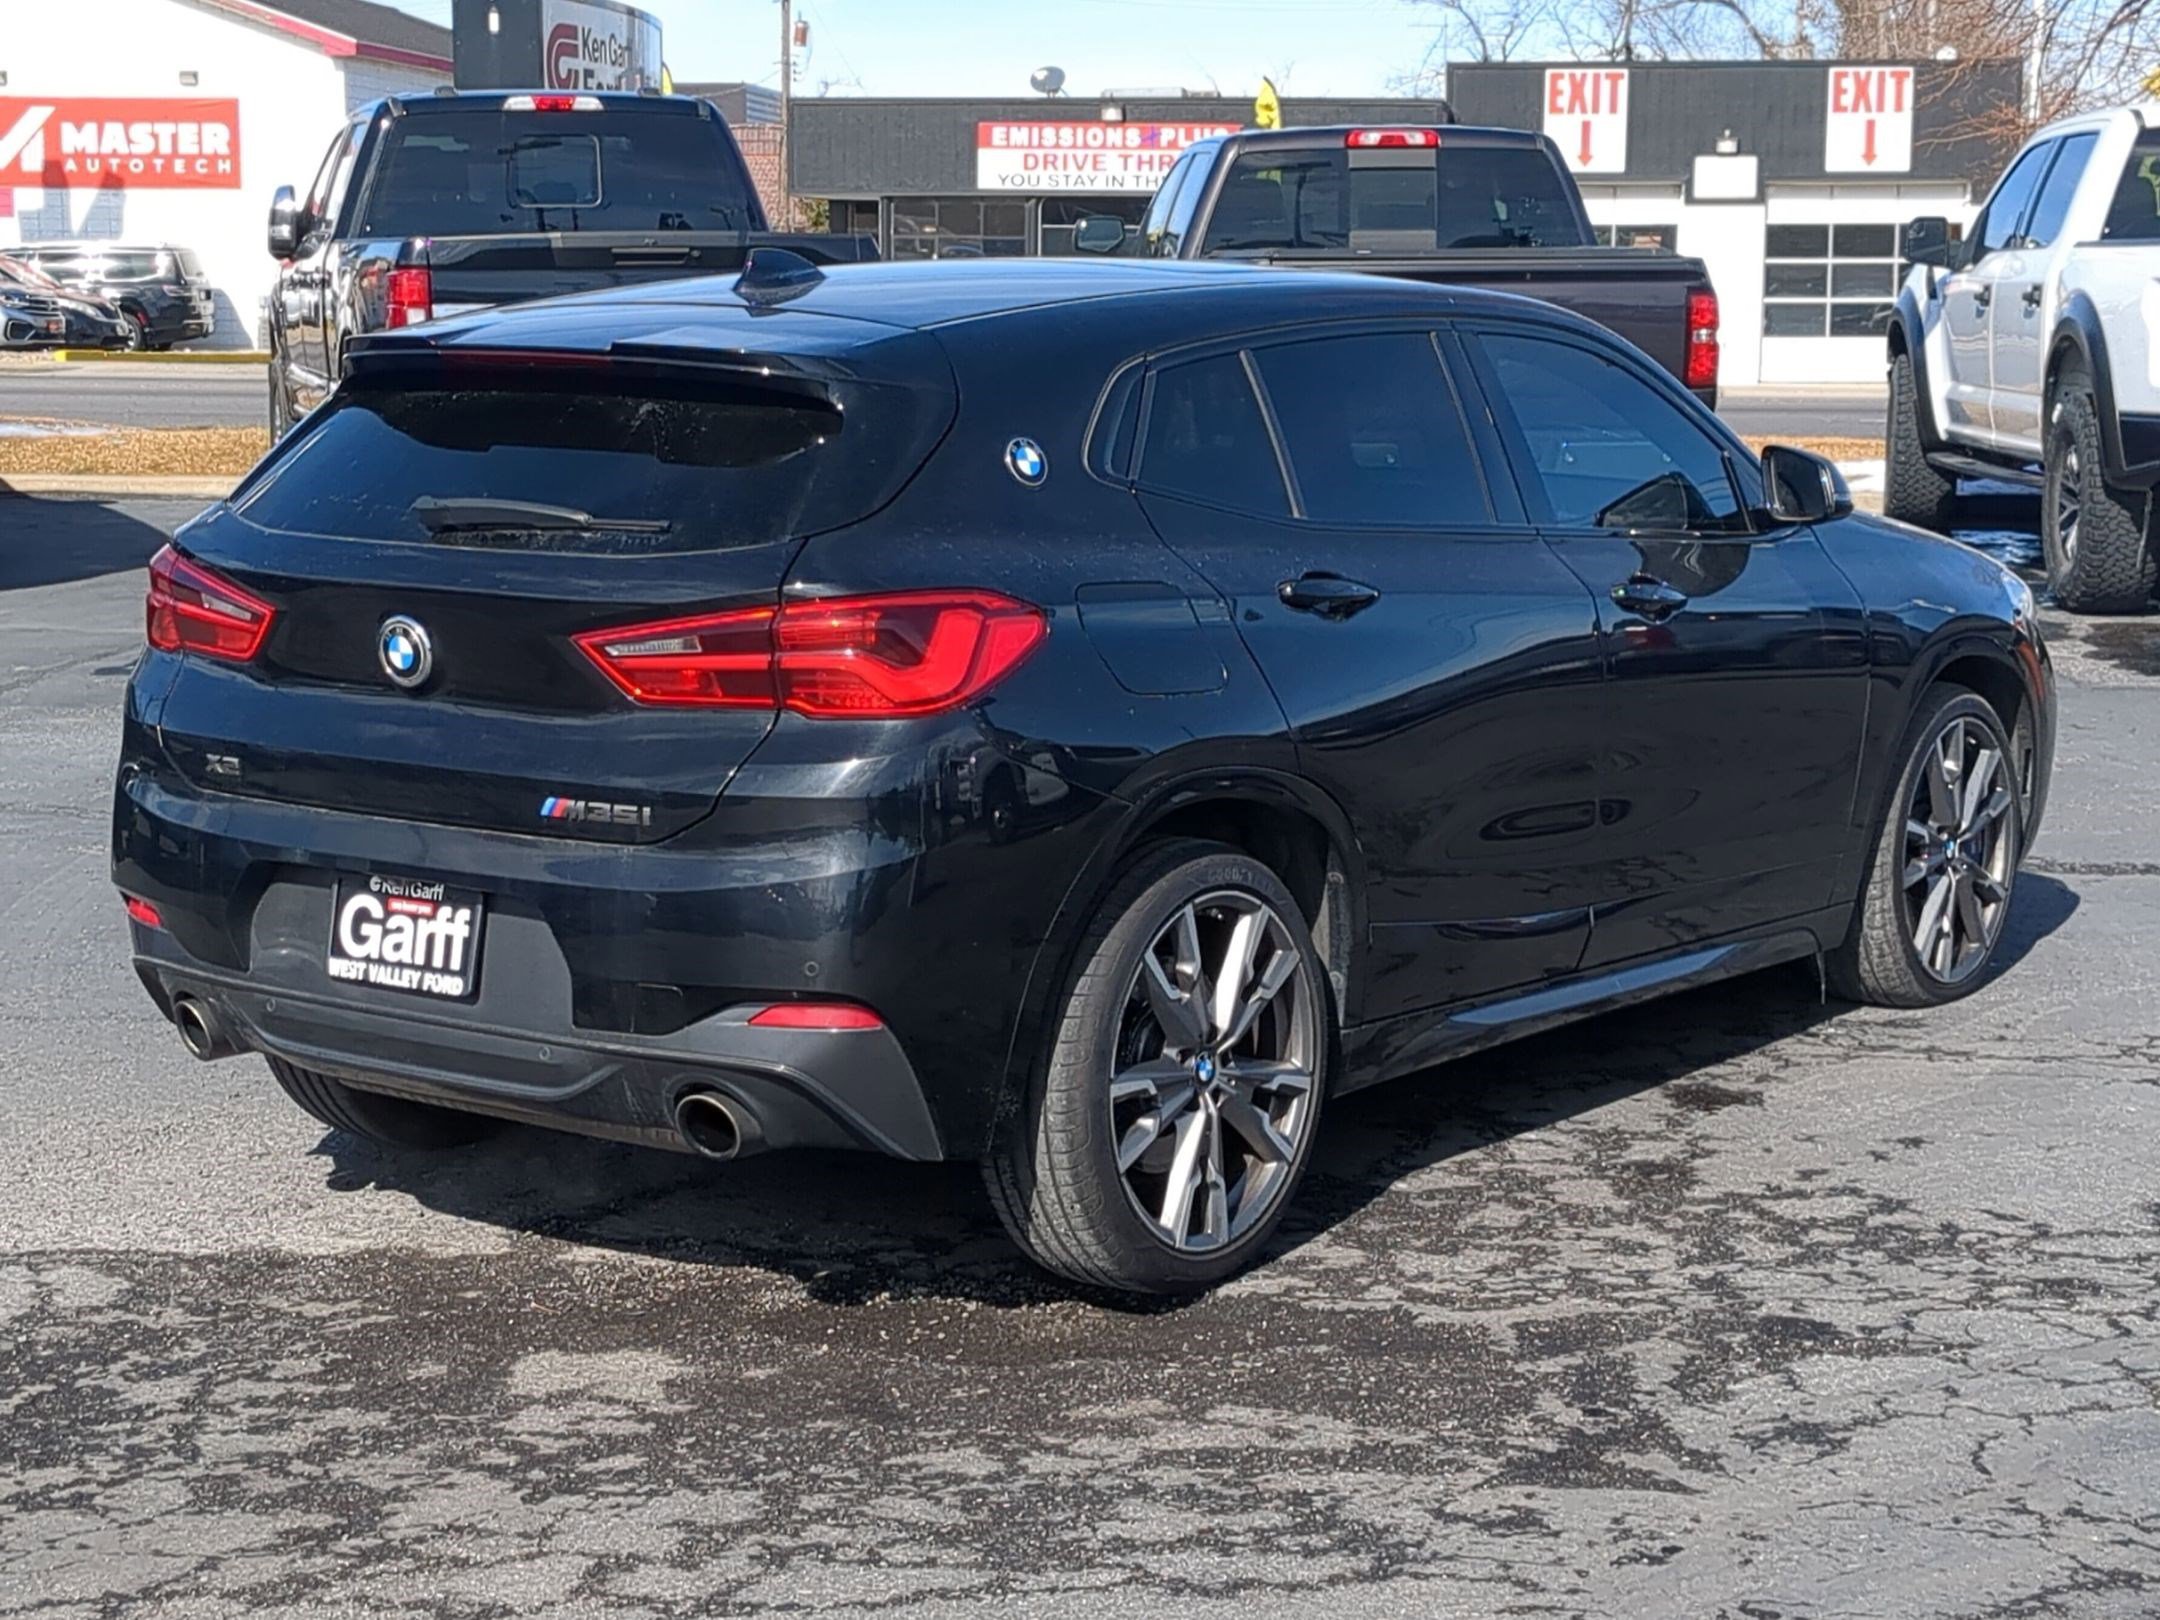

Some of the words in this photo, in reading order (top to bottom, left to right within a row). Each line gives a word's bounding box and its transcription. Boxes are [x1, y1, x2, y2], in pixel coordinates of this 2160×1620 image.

[582, 26, 607, 64] Ken
[1549, 73, 1625, 114] EXIT
[1832, 71, 1910, 112] EXIT
[60, 121, 230, 155] MASTER
[991, 127, 1141, 147] EMISSIONS
[64, 158, 232, 174] AUTOTECH
[1023, 154, 1107, 171] DRIVE
[1117, 154, 1175, 172] THR
[998, 174, 1040, 188] YOU
[1048, 174, 1098, 188] STAY
[1105, 174, 1125, 188] IN
[1132, 174, 1167, 189] TH
[206, 753, 240, 776] X2
[340, 893, 471, 971] Garff
[328, 957, 367, 980] WEST
[368, 963, 422, 990] VALLEY
[422, 971, 464, 997] FORD
